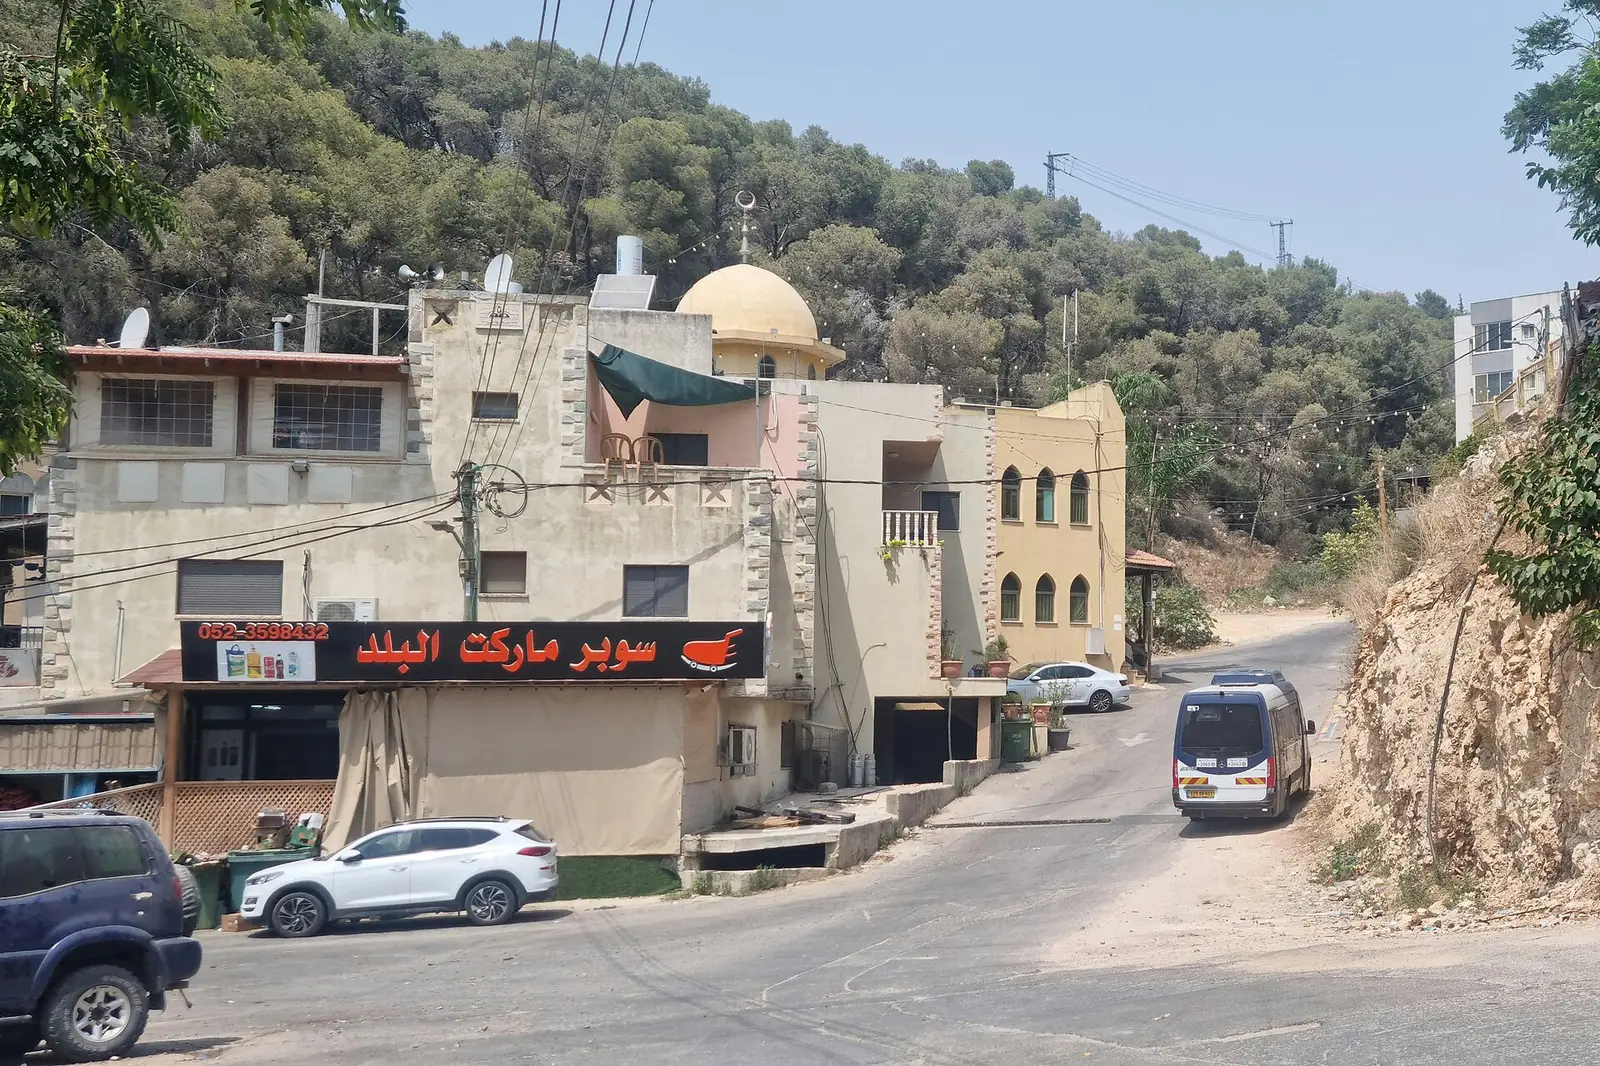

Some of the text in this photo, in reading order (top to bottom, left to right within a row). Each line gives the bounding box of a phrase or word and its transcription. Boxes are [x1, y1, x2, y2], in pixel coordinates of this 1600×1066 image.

[198, 622, 329, 640] 052-3598432
[357, 626, 656, 675] سوبر ماركت البلد
